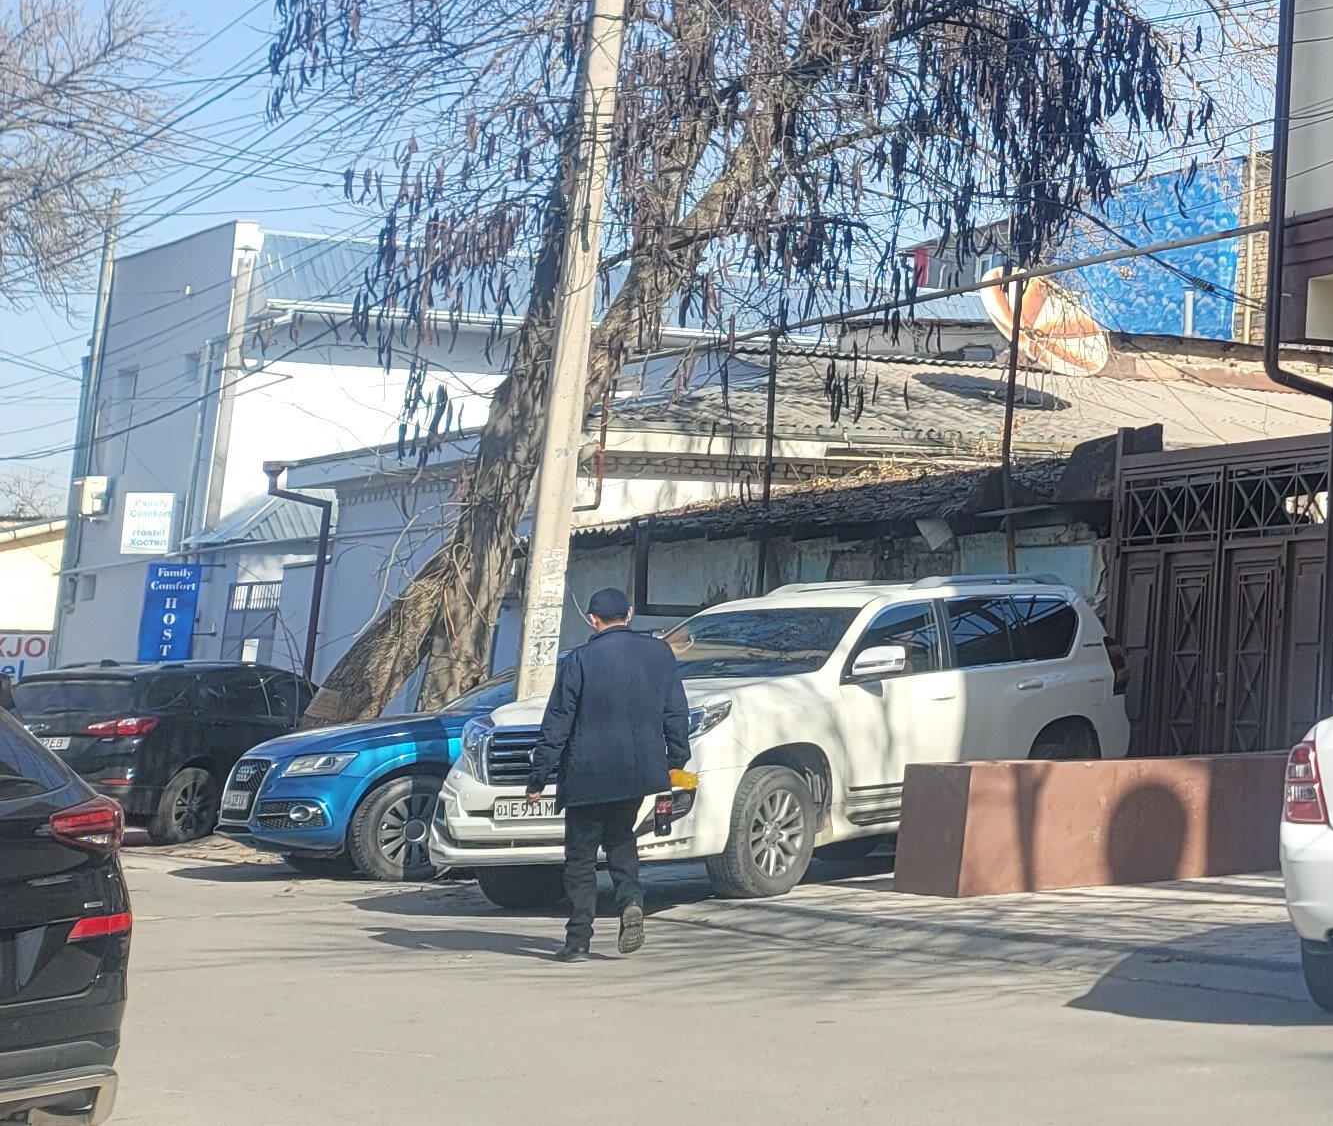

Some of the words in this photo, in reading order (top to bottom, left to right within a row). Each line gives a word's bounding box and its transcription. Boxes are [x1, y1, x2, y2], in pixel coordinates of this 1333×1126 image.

[157, 567, 193, 579] Family
[150, 580, 196, 591] Comfort
[158, 597, 178, 662] HOST
